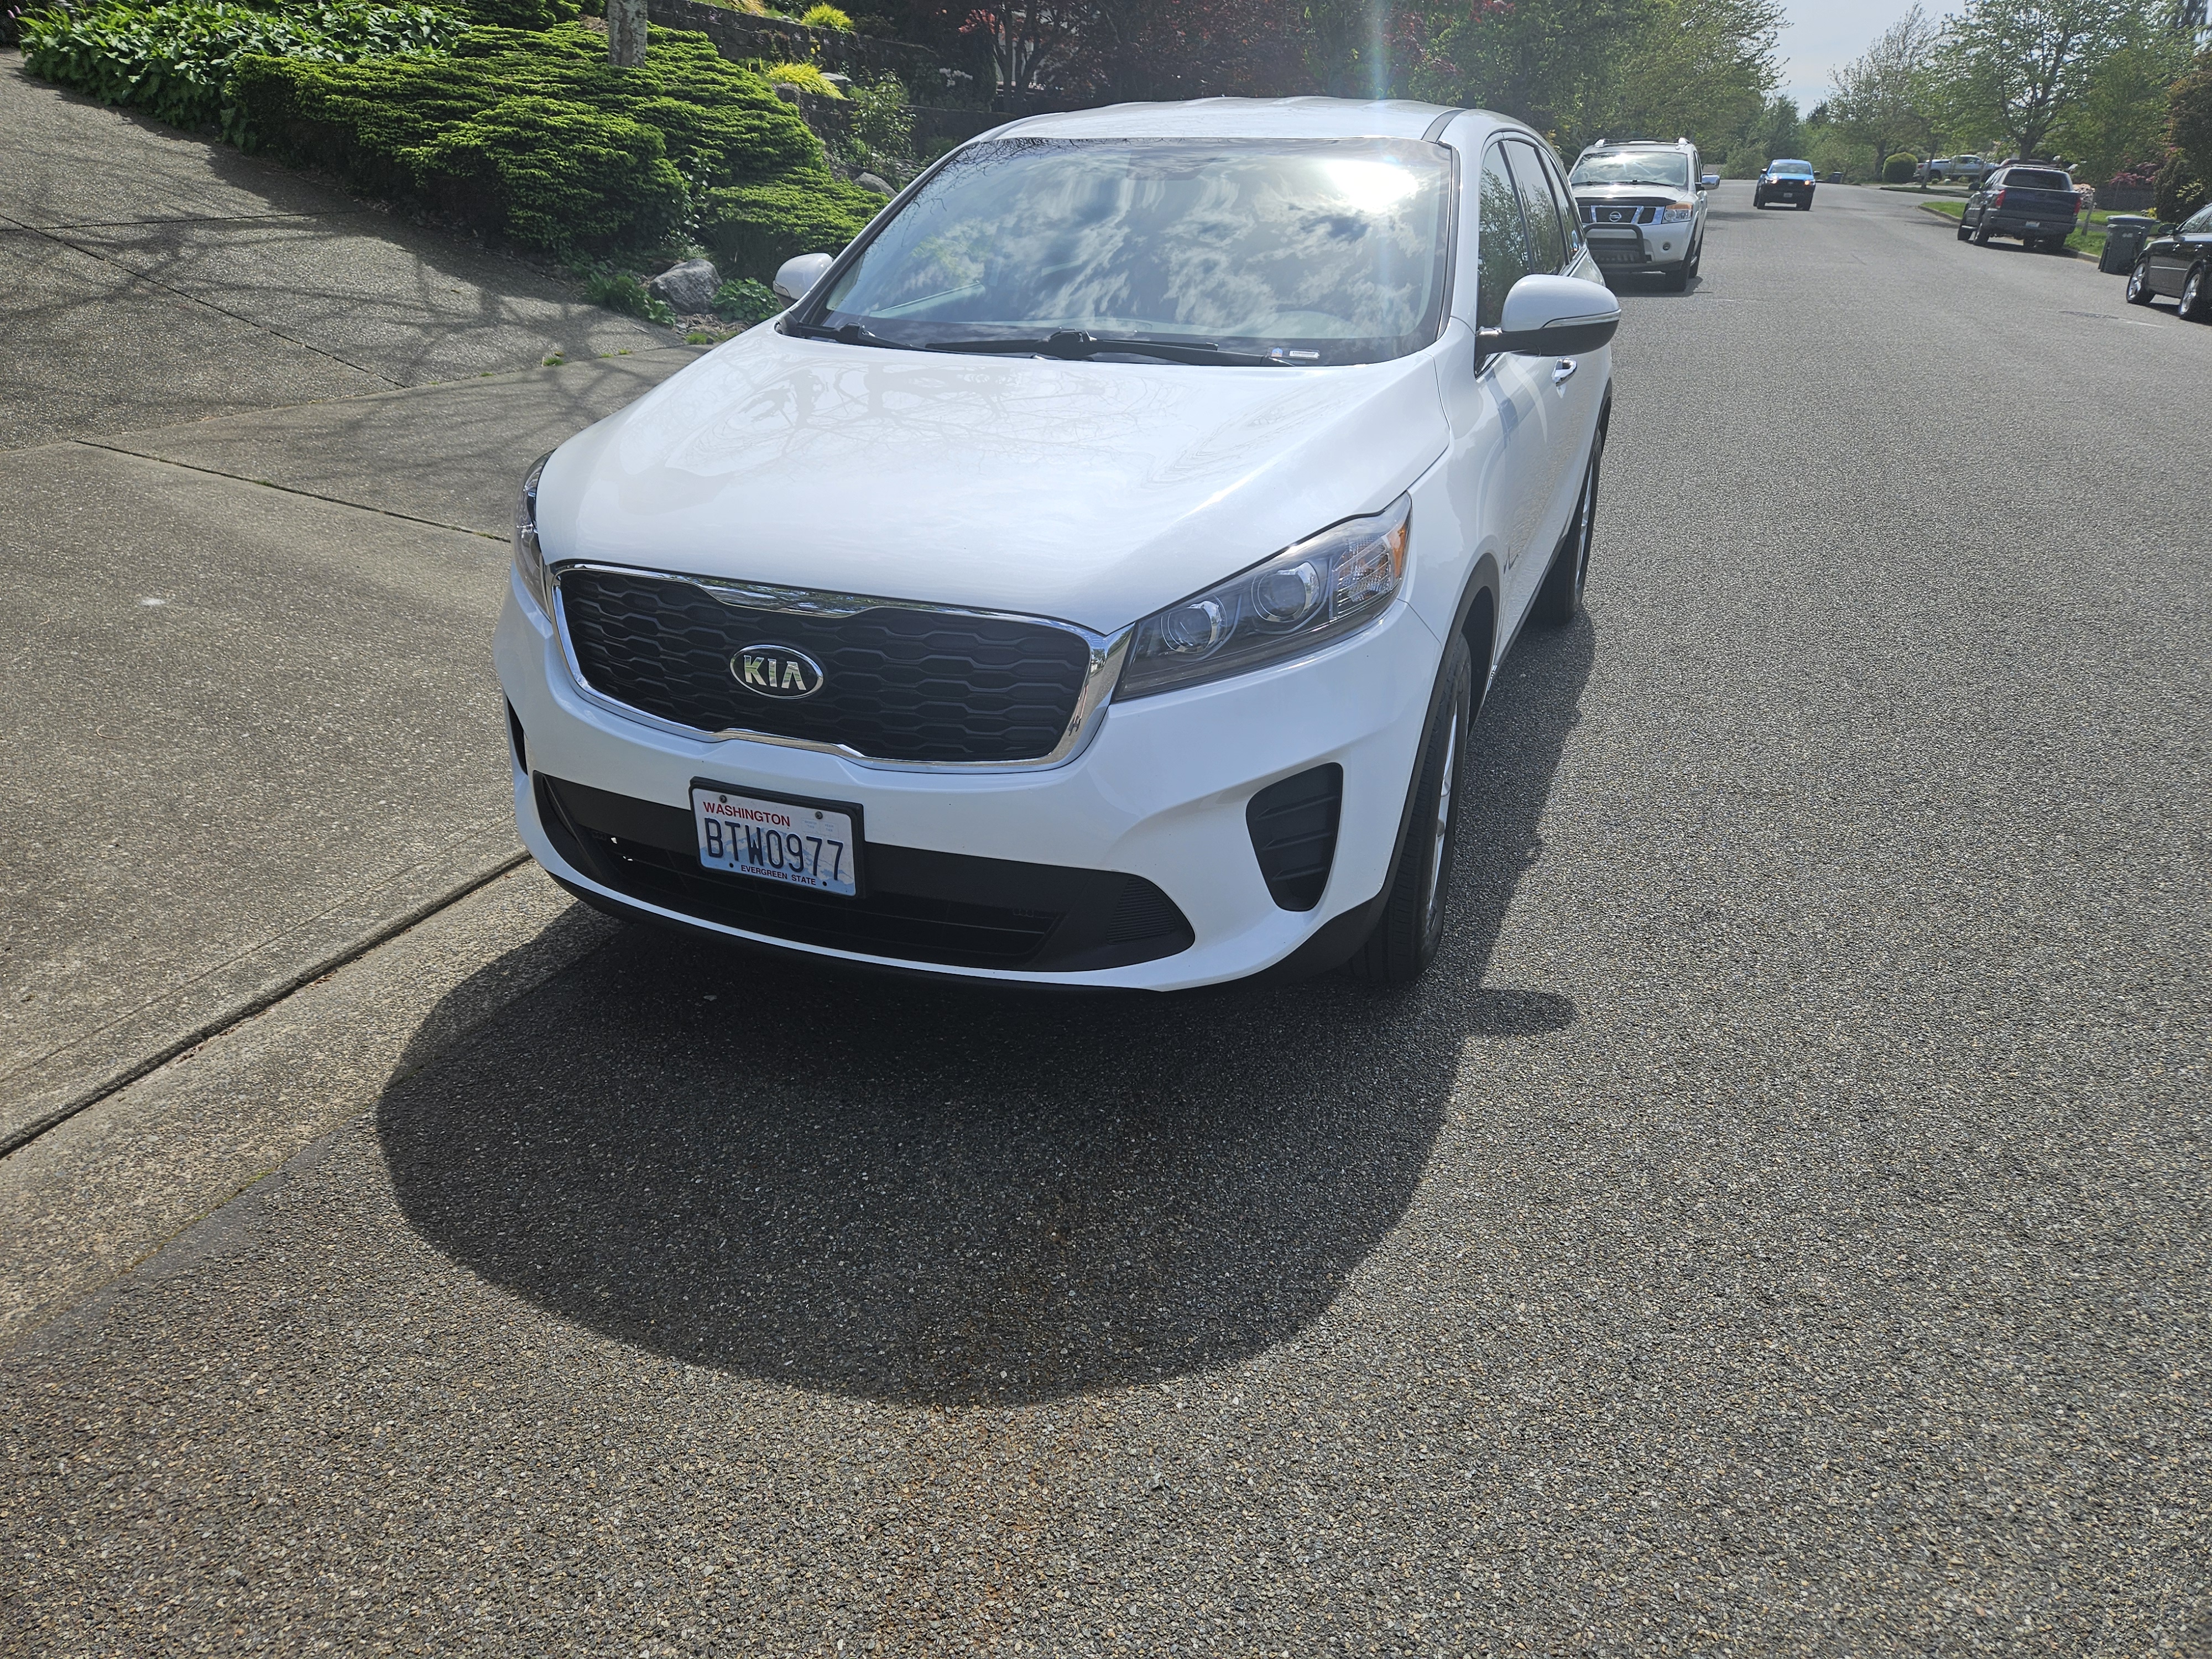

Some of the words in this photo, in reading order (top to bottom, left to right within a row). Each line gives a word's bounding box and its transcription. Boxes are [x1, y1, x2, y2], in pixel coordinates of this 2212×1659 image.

[744, 655, 806, 690] KIA
[703, 802, 790, 827] WASHINGTON
[704, 817, 844, 881] BTW0977
[741, 864, 787, 880] EVERGREEN
[791, 874, 816, 886] STATE
